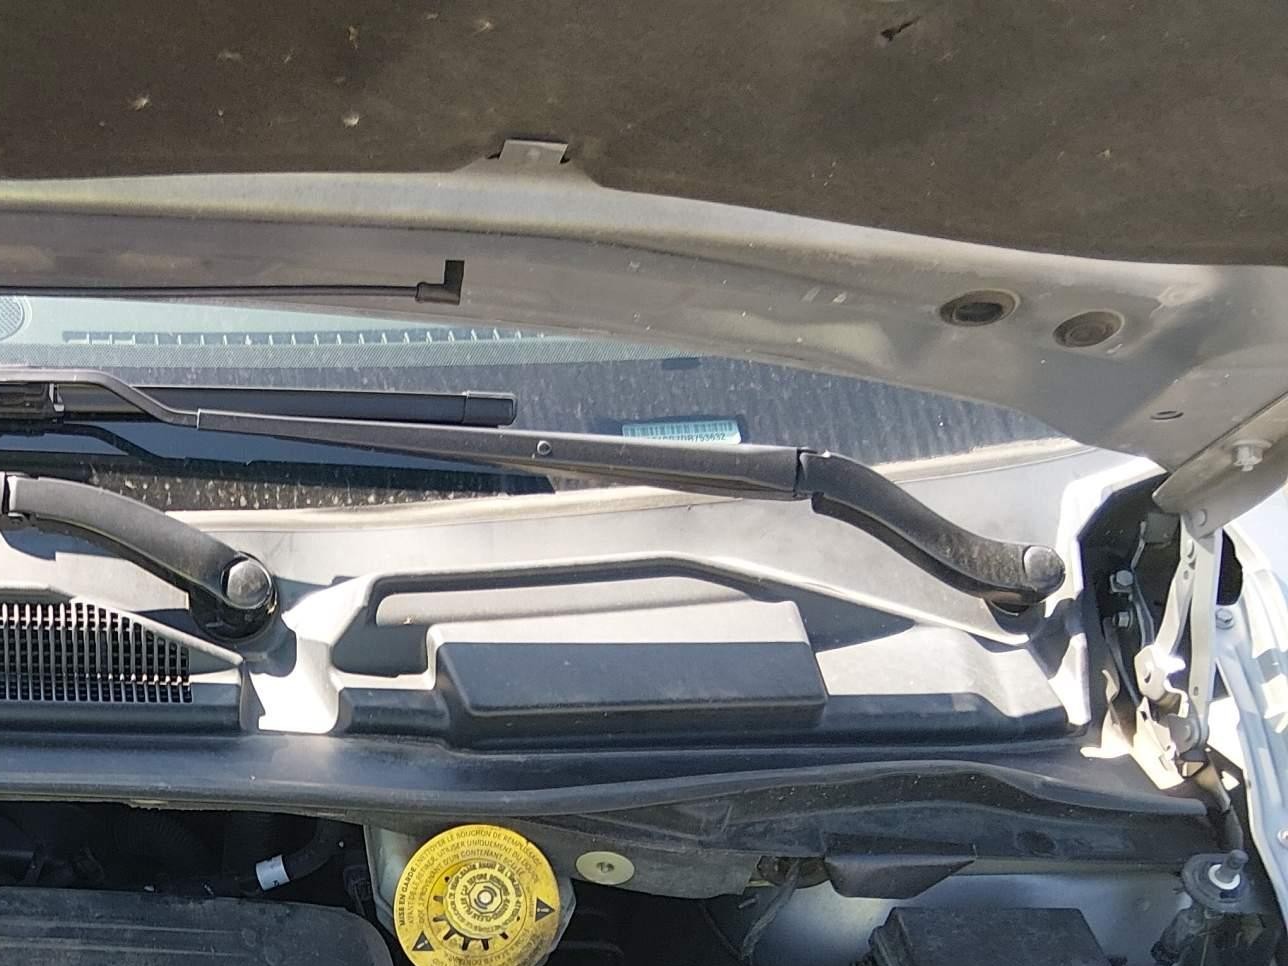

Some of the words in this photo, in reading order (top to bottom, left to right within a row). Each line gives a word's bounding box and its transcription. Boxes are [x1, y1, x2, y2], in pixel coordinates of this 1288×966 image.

[400, 865, 416, 893] GARDE
[398, 894, 405, 904] EN
[398, 907, 406, 926] MISE
